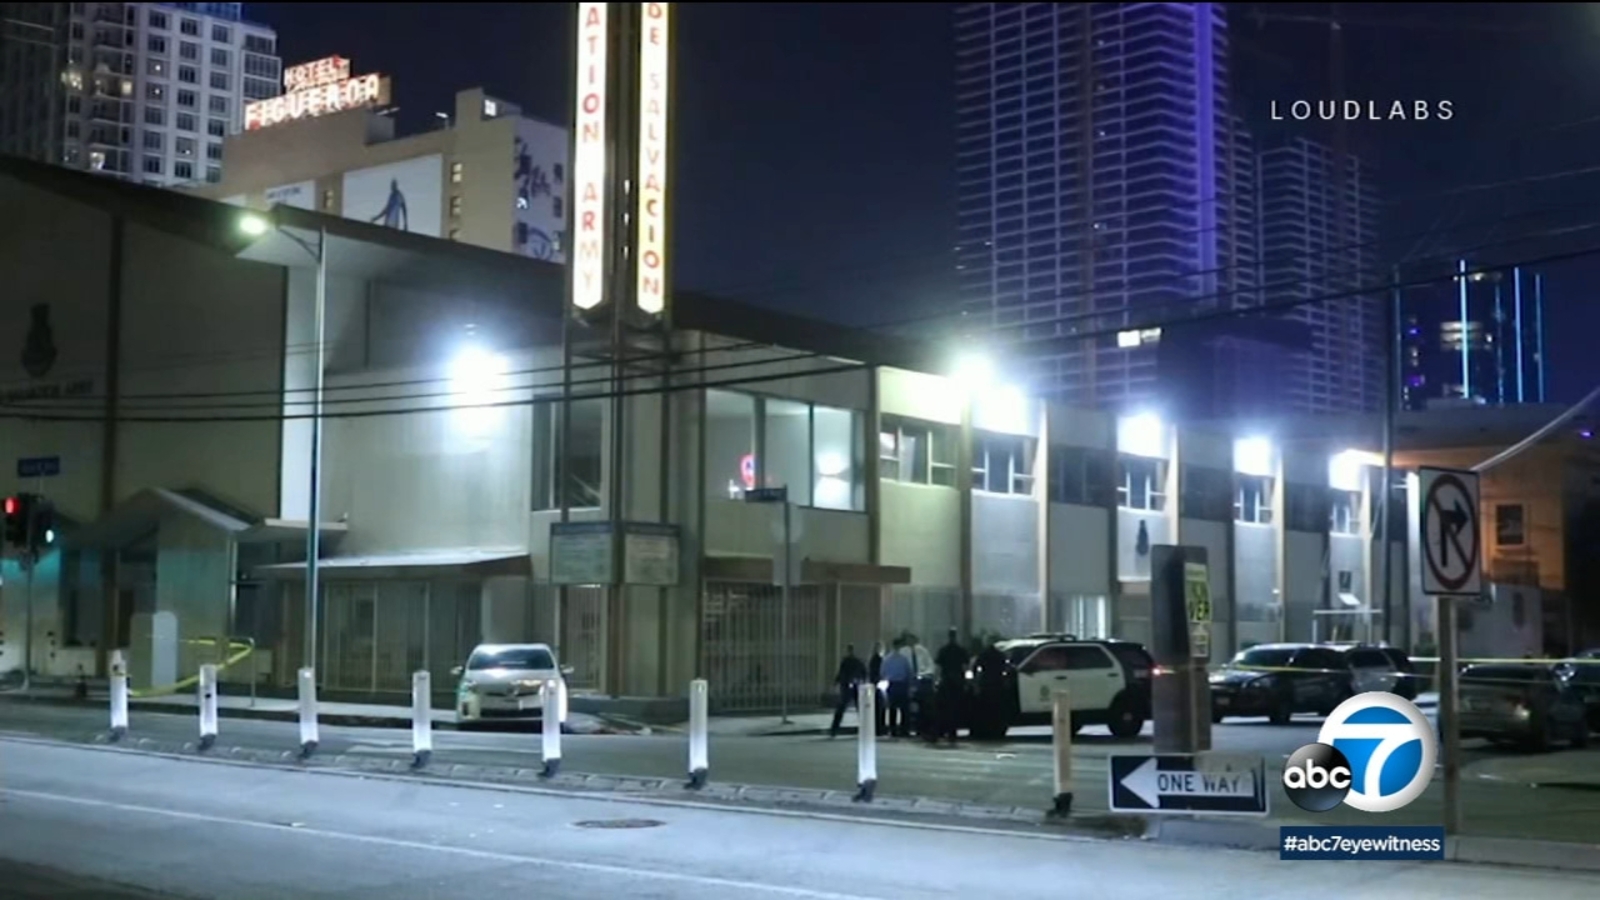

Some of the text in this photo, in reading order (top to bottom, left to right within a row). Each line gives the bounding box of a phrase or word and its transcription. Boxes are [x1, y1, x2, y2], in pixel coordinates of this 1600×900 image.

[284, 55, 344, 86] HOTEL
[245, 74, 380, 129] FIGUEROA
[580, 182, 600, 290] ARMY
[1157, 773, 1241, 793] ONE WAY
